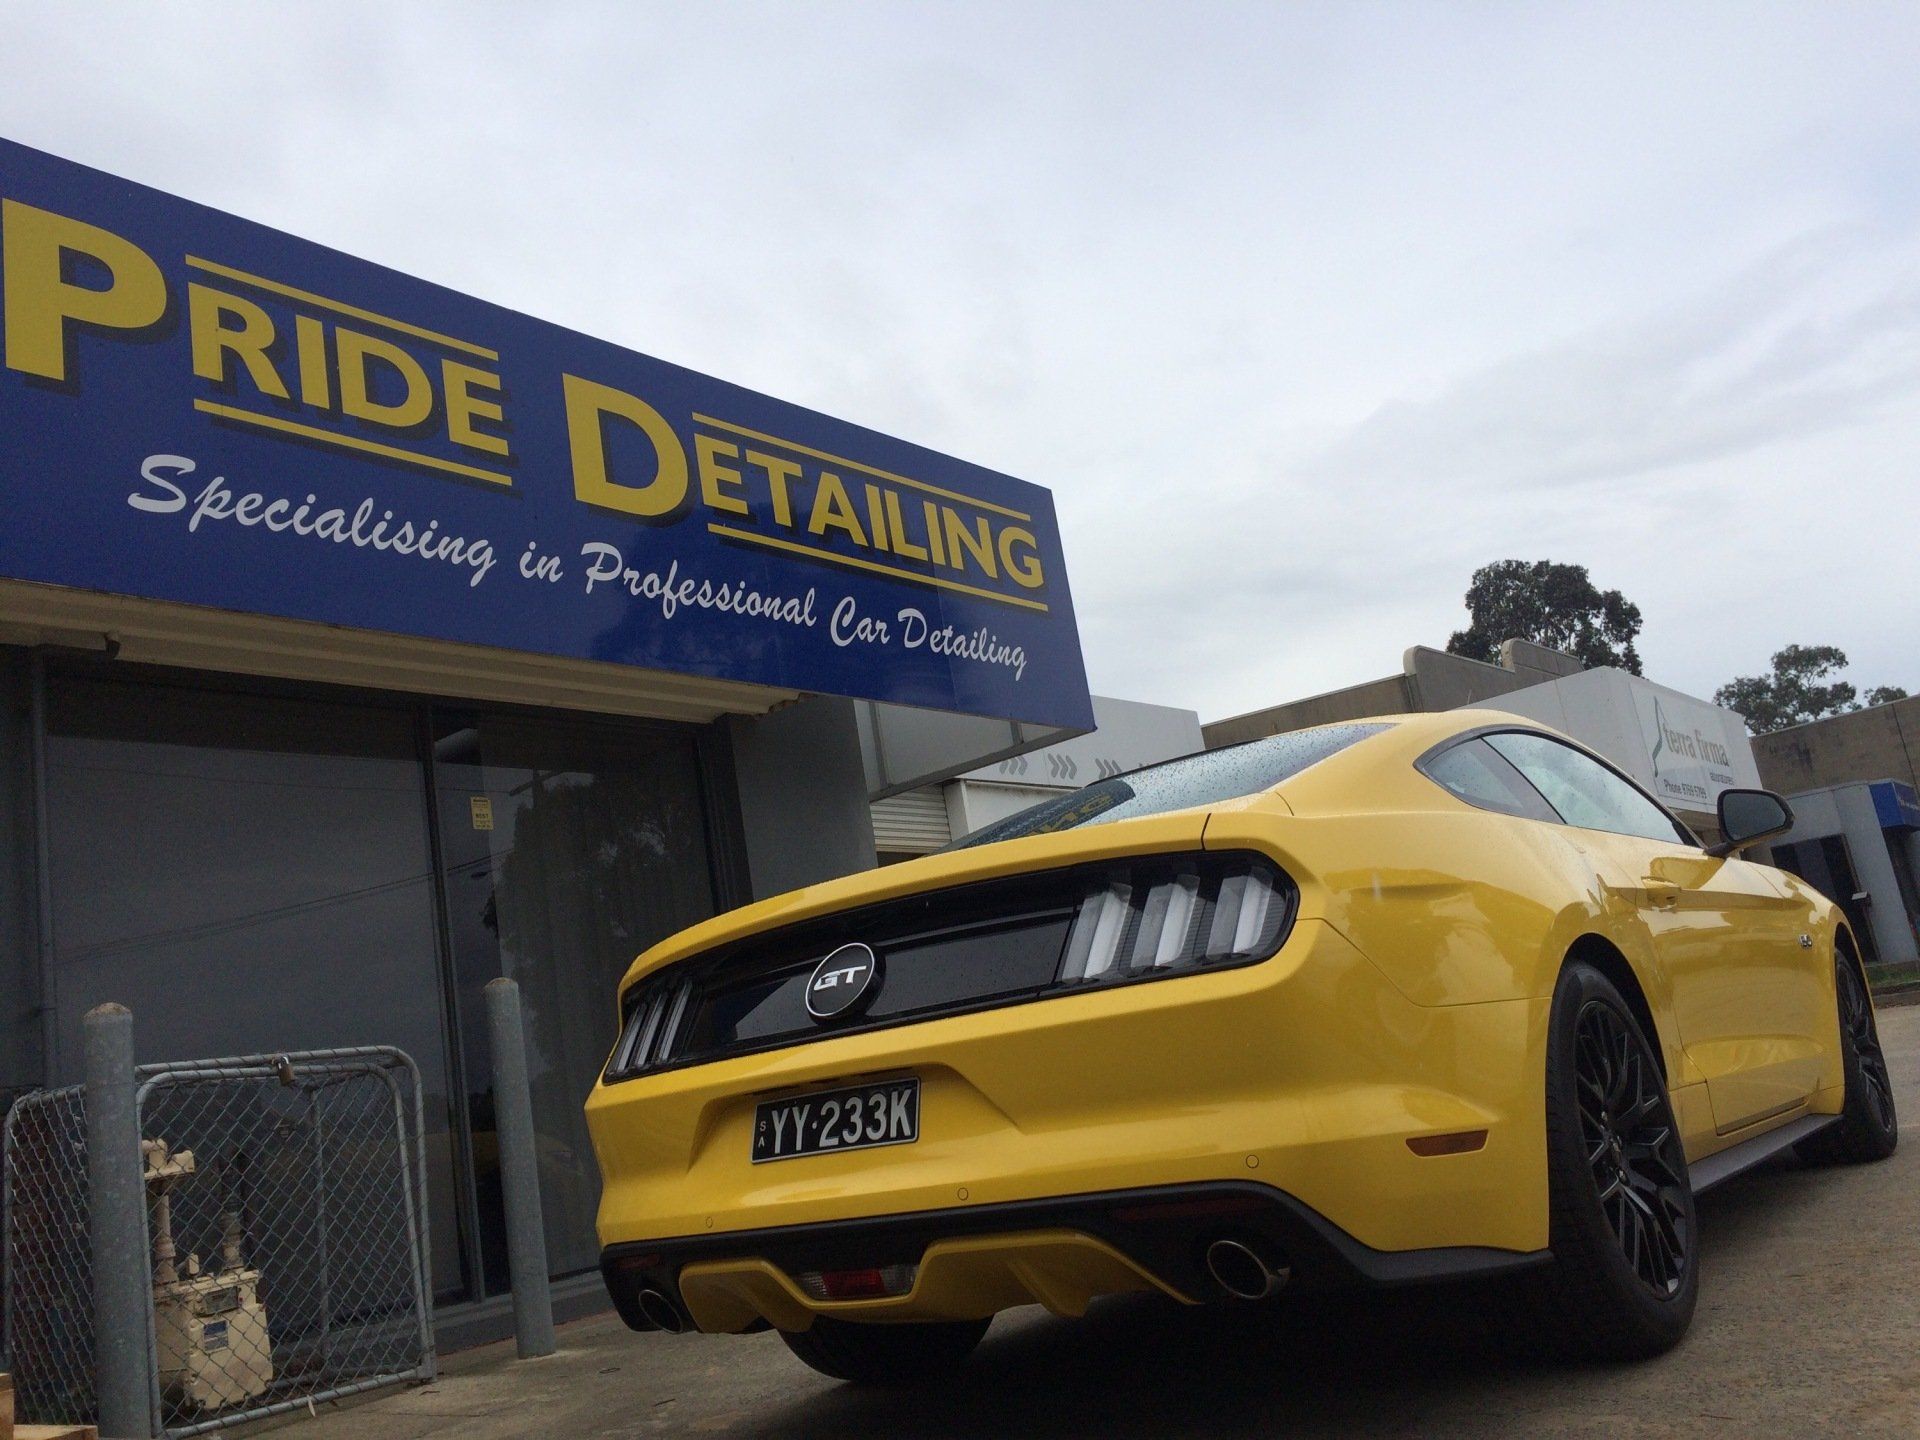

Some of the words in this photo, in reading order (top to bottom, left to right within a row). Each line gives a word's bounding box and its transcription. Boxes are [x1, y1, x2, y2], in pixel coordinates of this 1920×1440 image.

[2, 197, 510, 456] PRIDE
[562, 372, 1045, 588] DETAILING
[127, 454, 497, 587] Specialising
[519, 541, 564, 584] in
[581, 542, 817, 627] Professional
[830, 597, 890, 646] Car
[898, 608, 1027, 682] Detailing
[1663, 724, 1697, 760] terra
[1694, 730, 1730, 767] firma
[814, 965, 867, 991] GT
